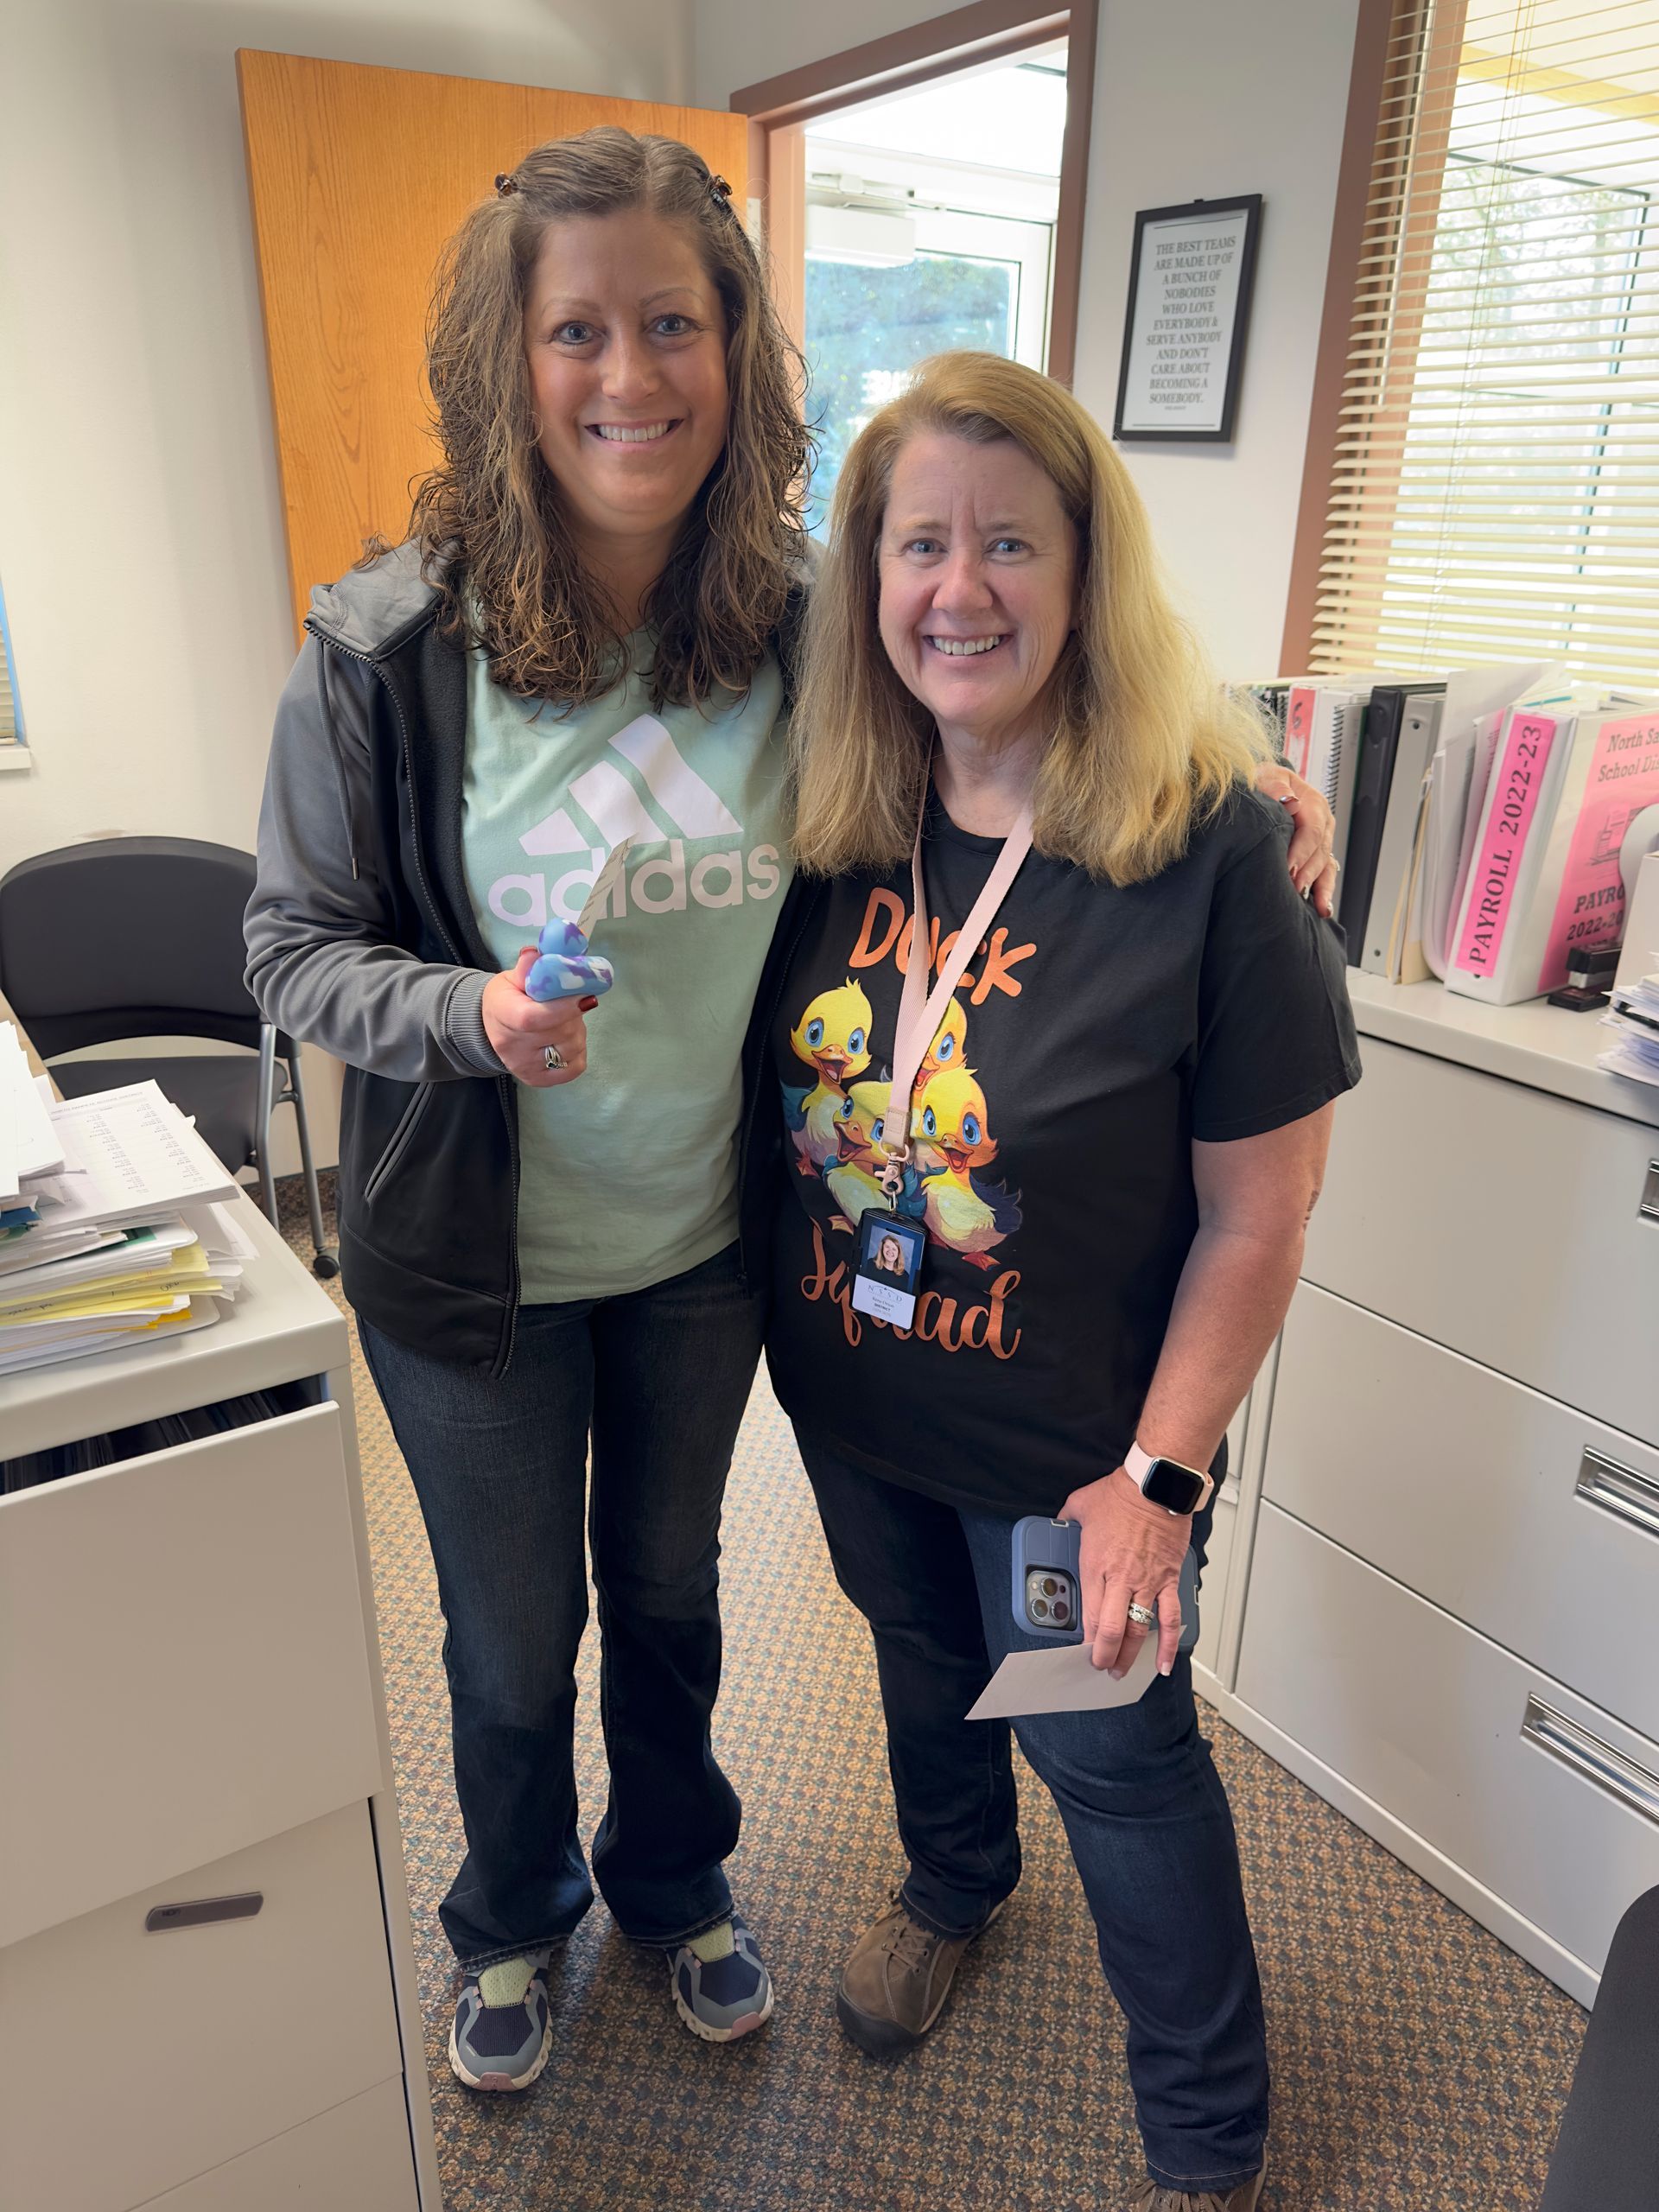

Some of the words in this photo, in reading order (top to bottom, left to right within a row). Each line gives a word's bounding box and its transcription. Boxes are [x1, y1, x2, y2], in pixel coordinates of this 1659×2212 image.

[1156, 243, 1175, 256] THE
[1176, 240, 1204, 253] BEST
[1205, 236, 1236, 251] TEAMS
[1154, 258, 1173, 270] ARE
[1174, 255, 1205, 268] MADE
[1207, 254, 1221, 266] UP
[1221, 251, 1234, 264] OF
[1162, 274, 1170, 285] A
[1171, 271, 1208, 284] BUNCH
[1209, 269, 1223, 281] OF
[1164, 286, 1217, 300] NOBODIES
[1162, 302, 1187, 315] WHO
[1189, 301, 1215, 314] LOVE
[1153, 317, 1211, 330] EVERYBODY
[1146, 334, 1176, 346] SERVE
[1176, 331, 1223, 344] ANYBODY
[1157, 348, 1179, 359] AND
[1151, 363, 1176, 375] CARE
[1178, 362, 1211, 374] ABOUT
[1149, 378, 1201, 390] BECOMING
[1202, 378, 1209, 389] A
[1148, 392, 1205, 404] SOMEBODY.
[1606, 730, 1643, 753] North
[1598, 758, 1641, 782] School
[1468, 849, 1513, 964] PAYROLL
[1499, 725, 1542, 836] 2022-23
[801, 1217, 1021, 1360] Sqad
